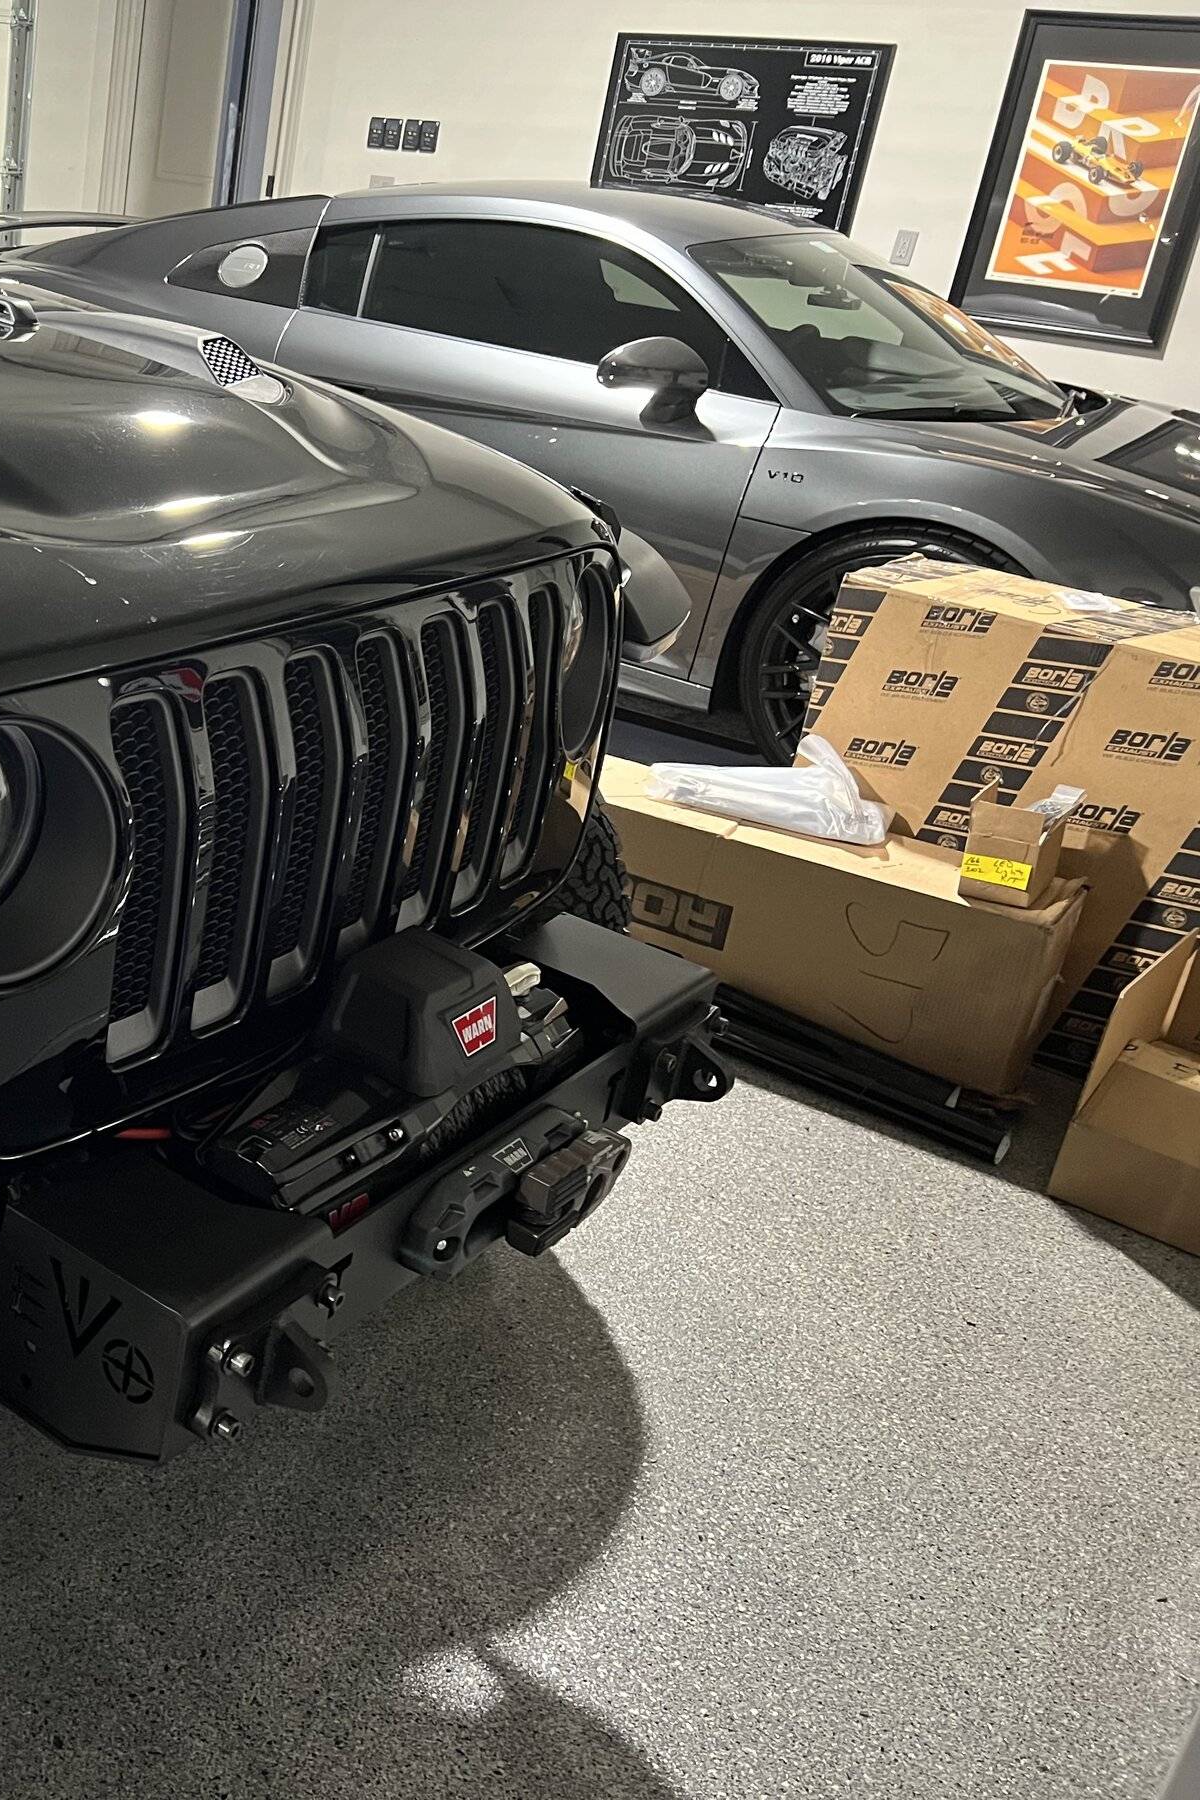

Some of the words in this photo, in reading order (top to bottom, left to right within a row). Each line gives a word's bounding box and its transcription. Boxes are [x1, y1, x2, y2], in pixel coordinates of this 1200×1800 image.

[768, 469, 804, 483] V10
[937, 810, 971, 827] Bor
[1161, 881, 1200, 898] Bor
[462, 1013, 494, 1044] WARN
